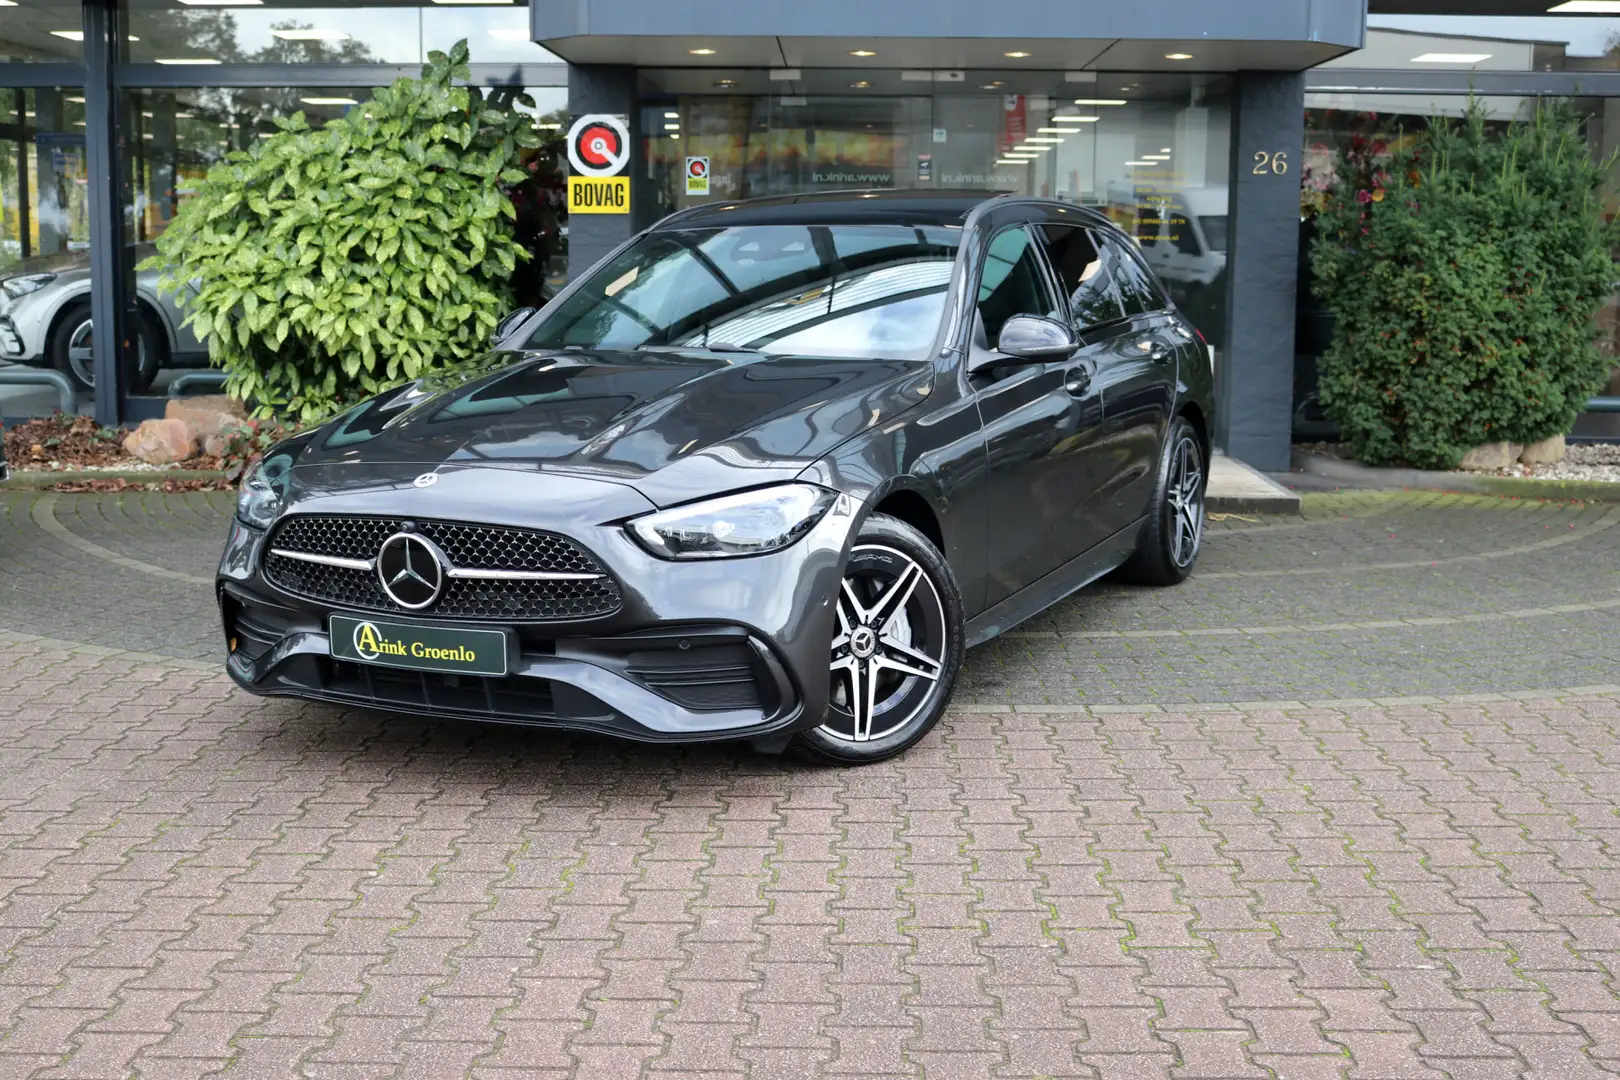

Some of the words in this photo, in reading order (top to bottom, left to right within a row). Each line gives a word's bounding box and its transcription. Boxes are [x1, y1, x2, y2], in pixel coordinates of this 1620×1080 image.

[1253, 151, 1288, 176] 26
[574, 183, 624, 207] BOVAG
[358, 624, 407, 656] Arink
[411, 642, 476, 662] Groenlo
